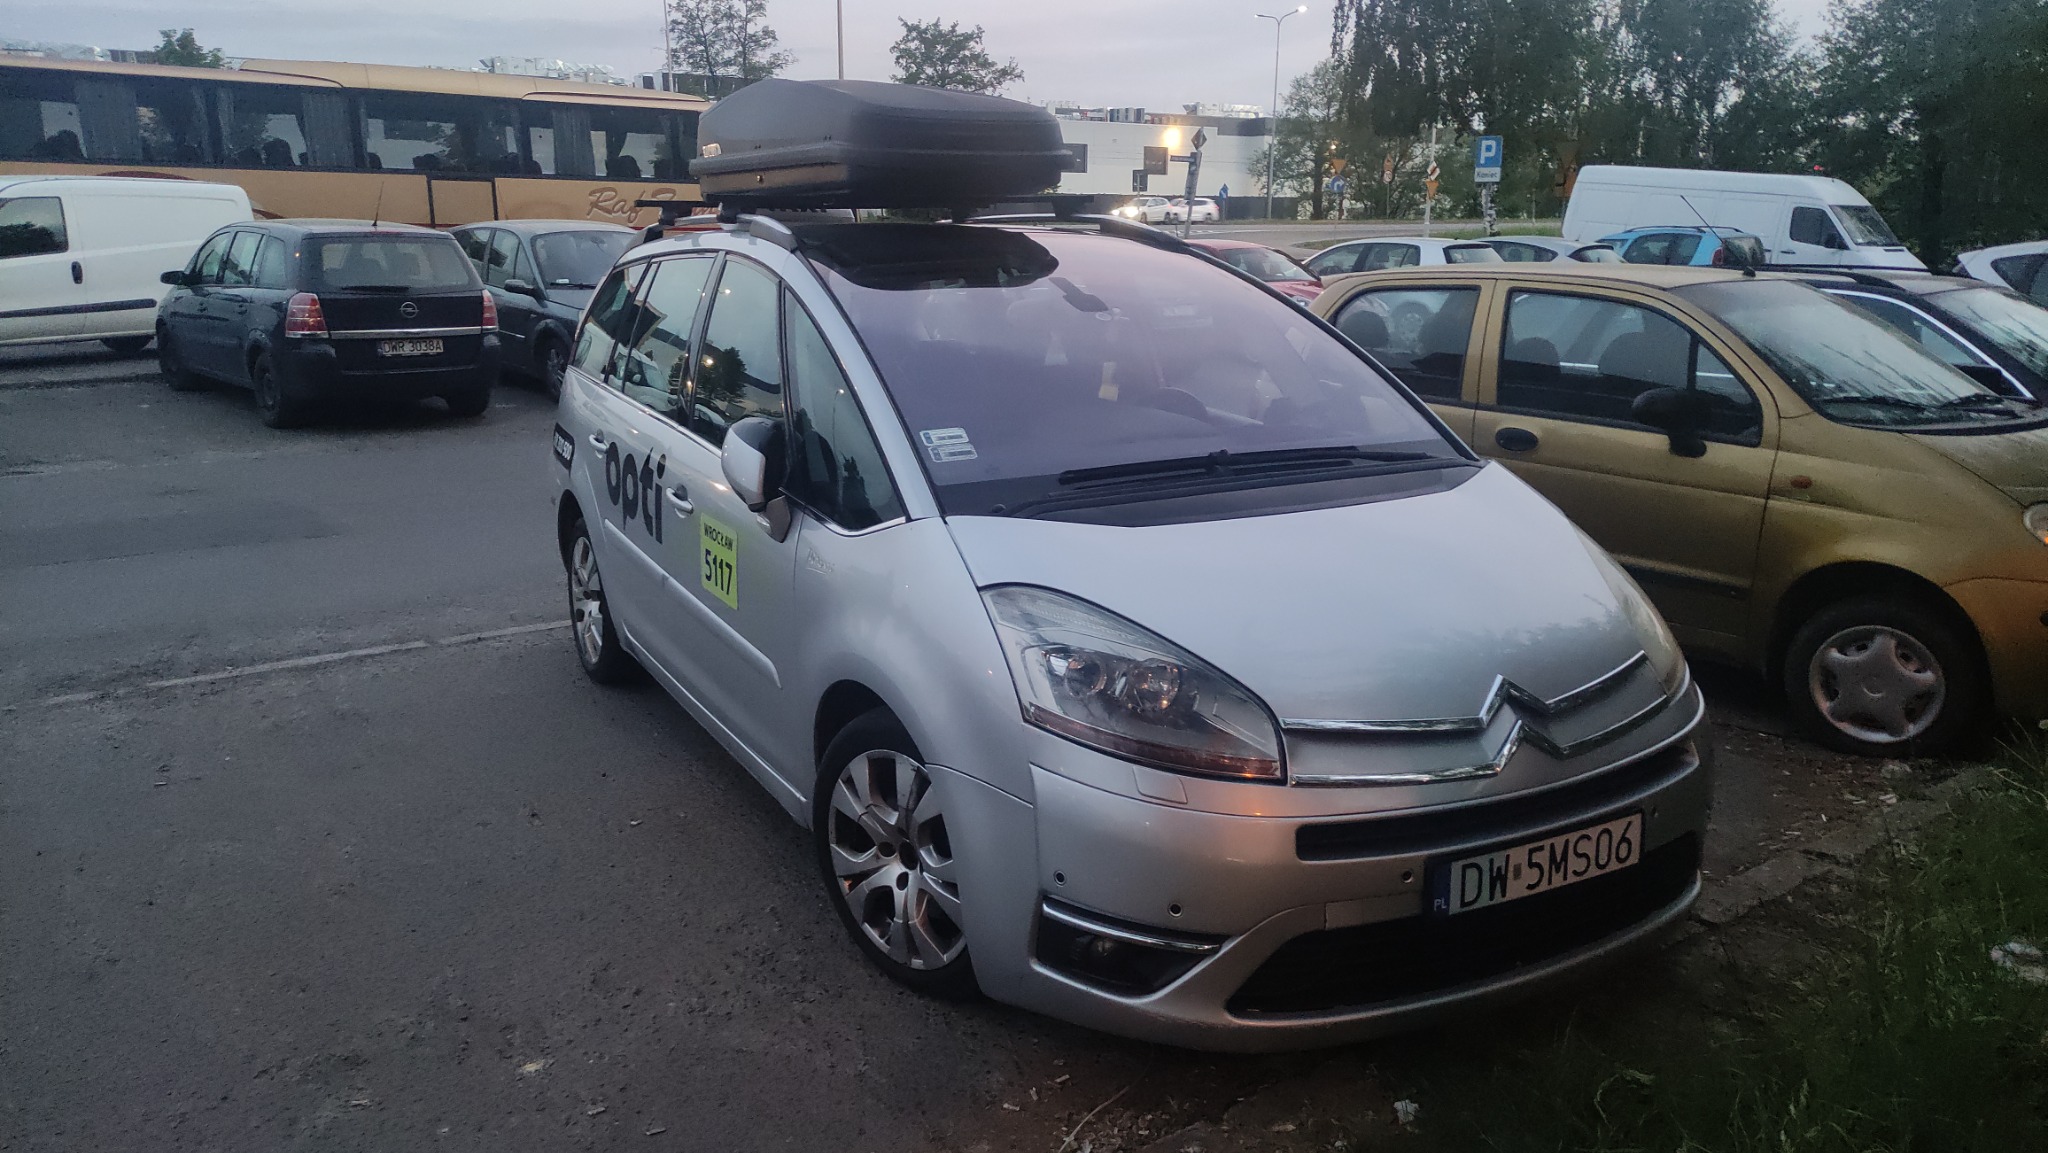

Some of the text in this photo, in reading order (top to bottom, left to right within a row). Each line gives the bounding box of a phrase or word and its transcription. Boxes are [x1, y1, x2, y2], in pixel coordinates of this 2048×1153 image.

[1480, 140, 1496, 164] P
[383, 340, 443, 354] DWR 3038A
[605, 441, 667, 545] opti
[703, 522, 734, 552] WROCŁAW
[704, 548, 733, 596] 5117
[1459, 820, 1633, 909] DW 5MS06
[1433, 898, 1448, 912] PL
